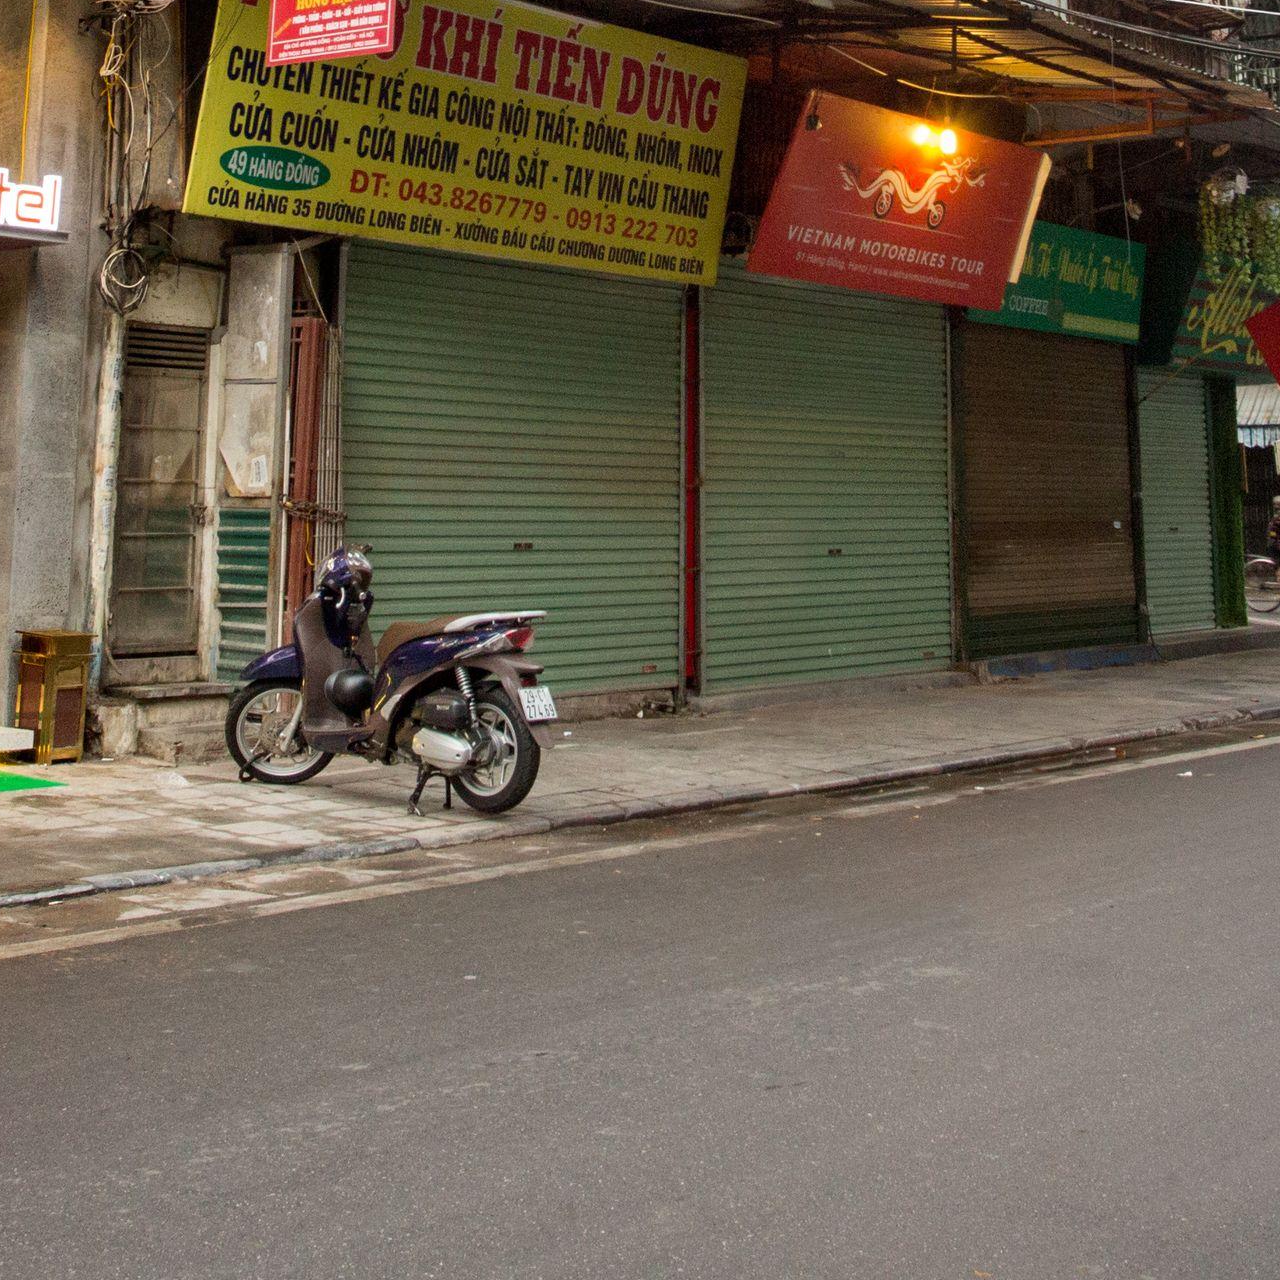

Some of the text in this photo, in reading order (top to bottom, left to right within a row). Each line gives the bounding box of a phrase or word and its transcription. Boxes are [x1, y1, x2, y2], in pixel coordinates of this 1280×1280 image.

[416, 7, 503, 84] KHÍ
[514, 23, 612, 109] TIẾN
[616, 52, 721, 133] DŨNG
[228, 90, 272, 142] CỬA
[279, 105, 339, 153] CUỐN
[356, 113, 395, 162] CỬA
[401, 132, 460, 175] NHÔM
[474, 137, 510, 183] CỬA
[514, 150, 549, 191] SẮT
[563, 165, 595, 199] TAY
[597, 171, 626, 210] VỊN
[627, 171, 660, 210] CẦU
[661, 184, 711, 220] THANG
[320, 60, 375, 105] THIẾT
[377, 69, 407, 112] KẾ
[408, 82, 439, 120] GIA
[444, 86, 496, 132] CÔNG
[499, 99, 530, 145] NỘI
[535, 105, 579, 149] THẤT:
[582, 113, 629, 162] ĐỒNG,
[634, 131, 684, 172] NHÔM,
[687, 144, 724, 179] INOX
[227, 150, 320, 187] 49 HÀNG ĐỒNG
[207, 180, 240, 208] CỬA
[244, 189, 288, 215] HÀNG
[291, 198, 311, 218] 35
[314, 200, 365, 225] ĐƯỜNG
[370, 209, 406, 231] LONG
[409, 211, 441, 236] BIÊN
[454, 216, 498, 245] XƯỞNG
[501, 225, 528, 250] ĐẦU
[530, 230, 555, 254] CẦU
[557, 237, 605, 262] CHƯƠNG
[607, 246, 646, 268] DƯƠNG
[648, 251, 677, 271] LONG
[679, 255, 705, 276] BIÊN
[350, 169, 390, 198] ĐT:
[398, 179, 547, 224] 043.8267779
[566, 207, 616, 236] 0913
[621, 219, 658, 243] 222
[665, 224, 699, 249] 703
[787, 224, 986, 277] VIETNAM MOTORBIKES TOUR
[1009, 294, 1050, 317] COFFEE
[524, 689, 546, 704] 29-C1
